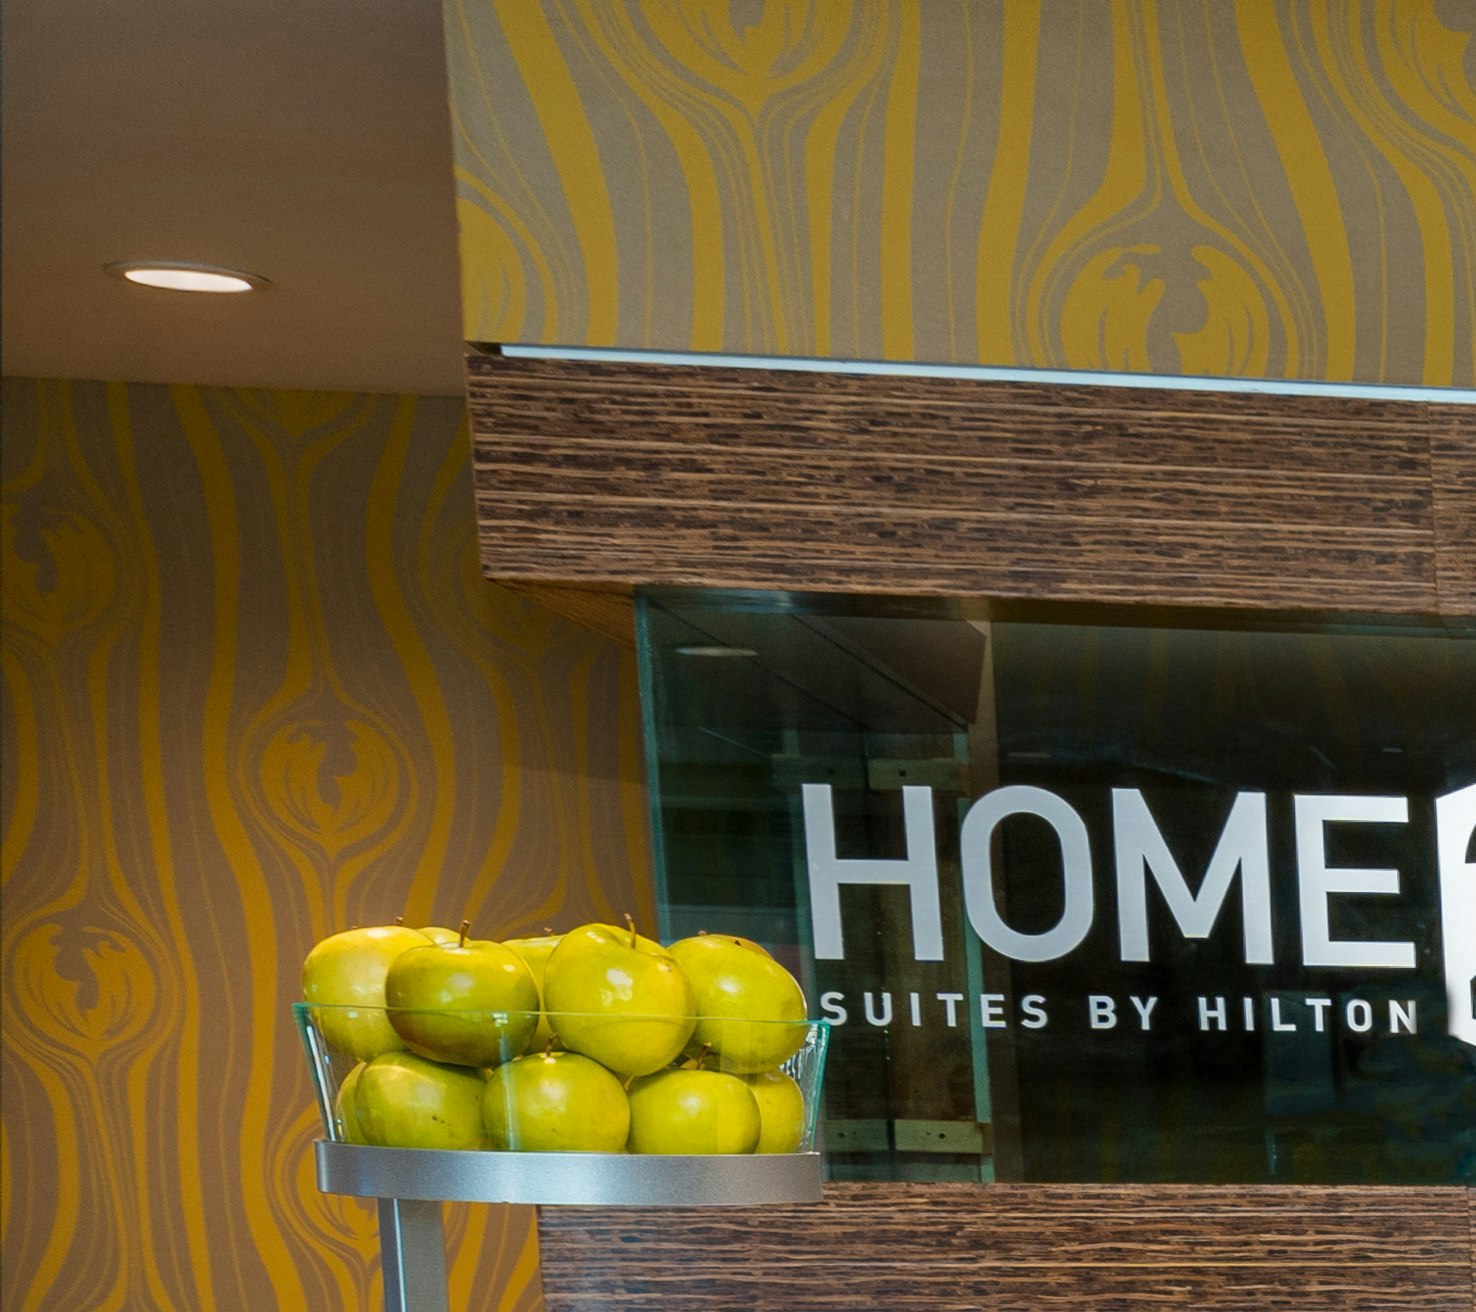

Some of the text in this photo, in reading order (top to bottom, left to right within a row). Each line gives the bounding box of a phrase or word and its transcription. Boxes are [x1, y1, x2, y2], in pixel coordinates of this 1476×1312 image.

[820, 990, 1418, 1035] SUITES BY HILTON
